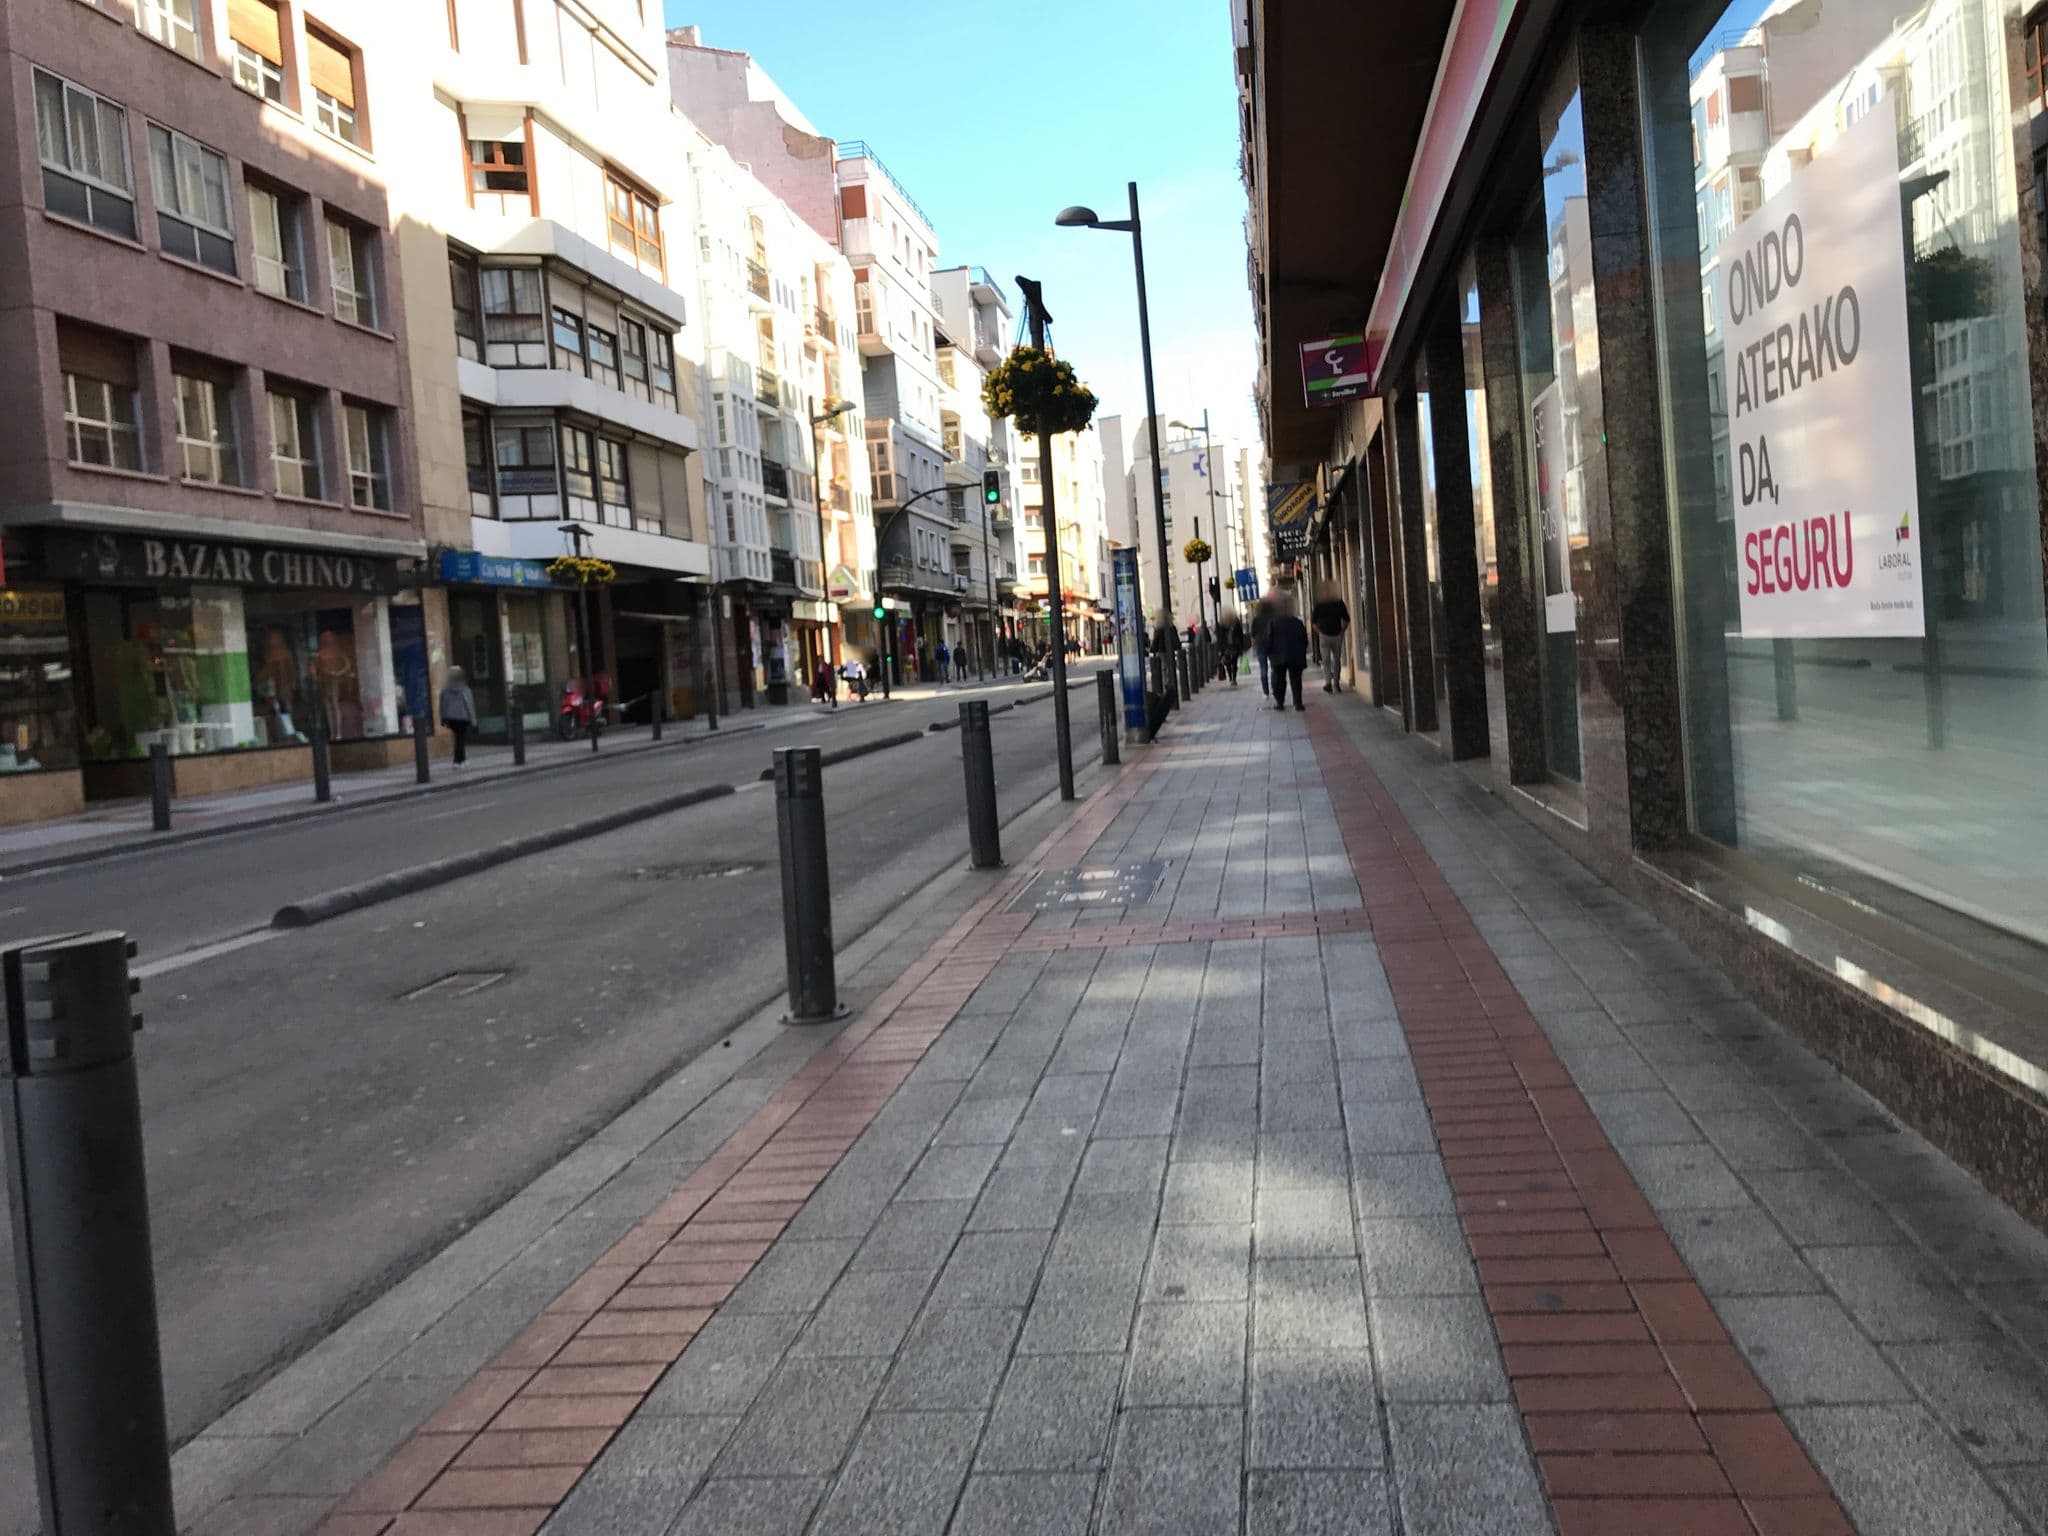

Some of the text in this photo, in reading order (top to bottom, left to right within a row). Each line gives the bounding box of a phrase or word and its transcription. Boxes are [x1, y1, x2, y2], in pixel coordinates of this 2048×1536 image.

[1729, 213, 1803, 325] ONDO
[1736, 285, 1860, 418] ATERAKO
[1739, 435, 1779, 505] DA,
[143, 540, 353, 589] BAZAR CHINO
[1745, 511, 1853, 596] SEGURU
[1878, 552, 1911, 570] LABORAL
